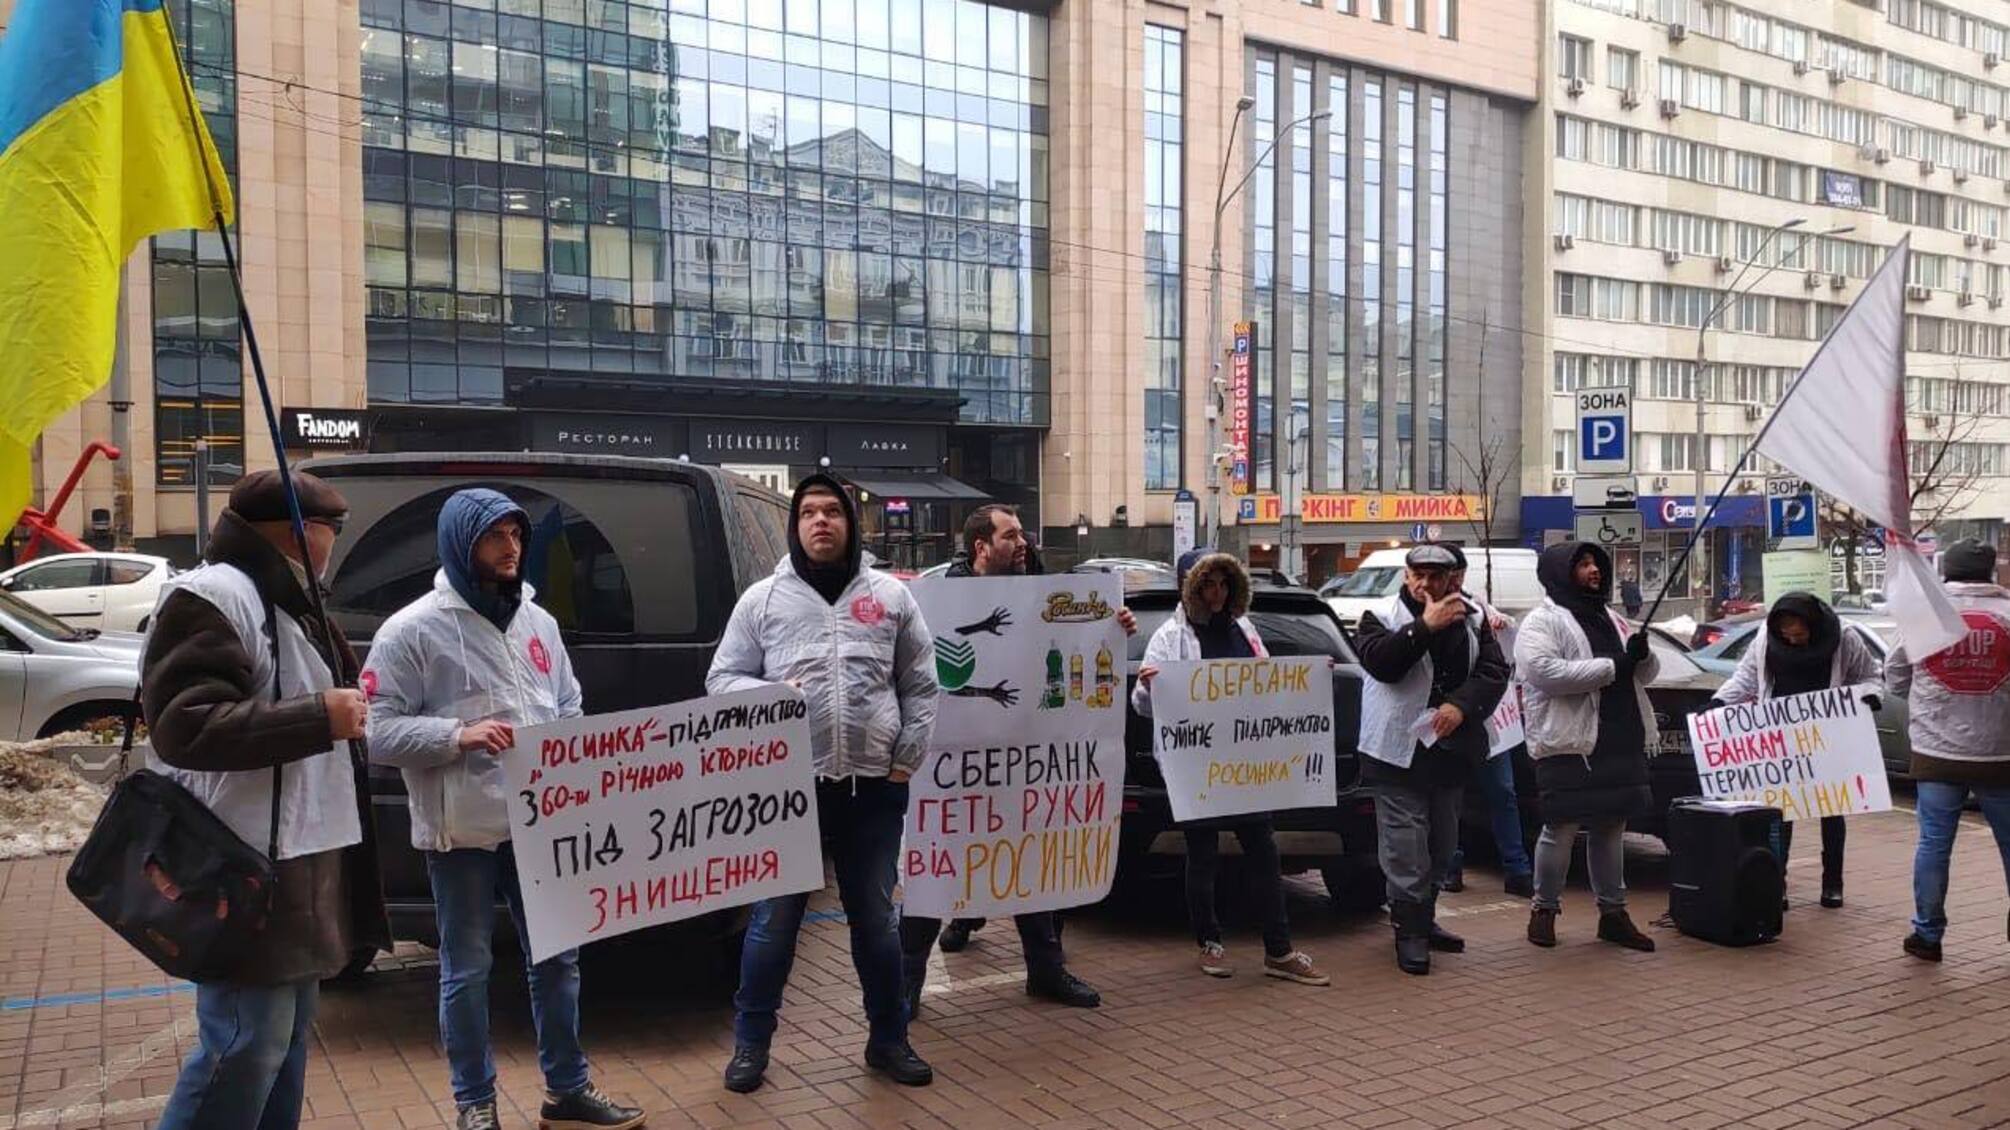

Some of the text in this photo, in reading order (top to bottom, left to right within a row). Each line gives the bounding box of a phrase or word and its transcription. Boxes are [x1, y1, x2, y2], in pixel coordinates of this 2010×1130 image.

[1235, 356, 1248, 460] ШИНОМОНТАЖ
[1580, 394, 1627, 410] ЗОНА
[558, 431, 653, 446] РЕСТОРАН
[707, 434, 801, 451] STEAKHOUSE
[861, 440, 908, 451] ЛАВКА
[1593, 421, 1616, 456] P
[1265, 498, 1357, 518] ПРКІНГ
[1396, 497, 1468, 517] МИЙКА
[1190, 661, 1313, 703] СБЕРБАНК
[1695, 710, 1721, 742] НІ
[1704, 729, 1789, 768] БАНКАМ
[1793, 723, 1827, 754] НА
[601, 762, 684, 798] РІЧНОЮ
[700, 739, 789, 777] ІСТОРІЄЮ
[933, 740, 1101, 789] СБЕРБАНК
[1700, 753, 1815, 795] ТЕРИТОРІЇ
[918, 781, 1106, 835] ГЕТЬ РУКИ
[552, 790, 808, 878] ПІД ЗАГРОЗОЮ
[907, 841, 957, 878] ВІД
[588, 850, 779, 933] ЗНИЩЕННЯ
